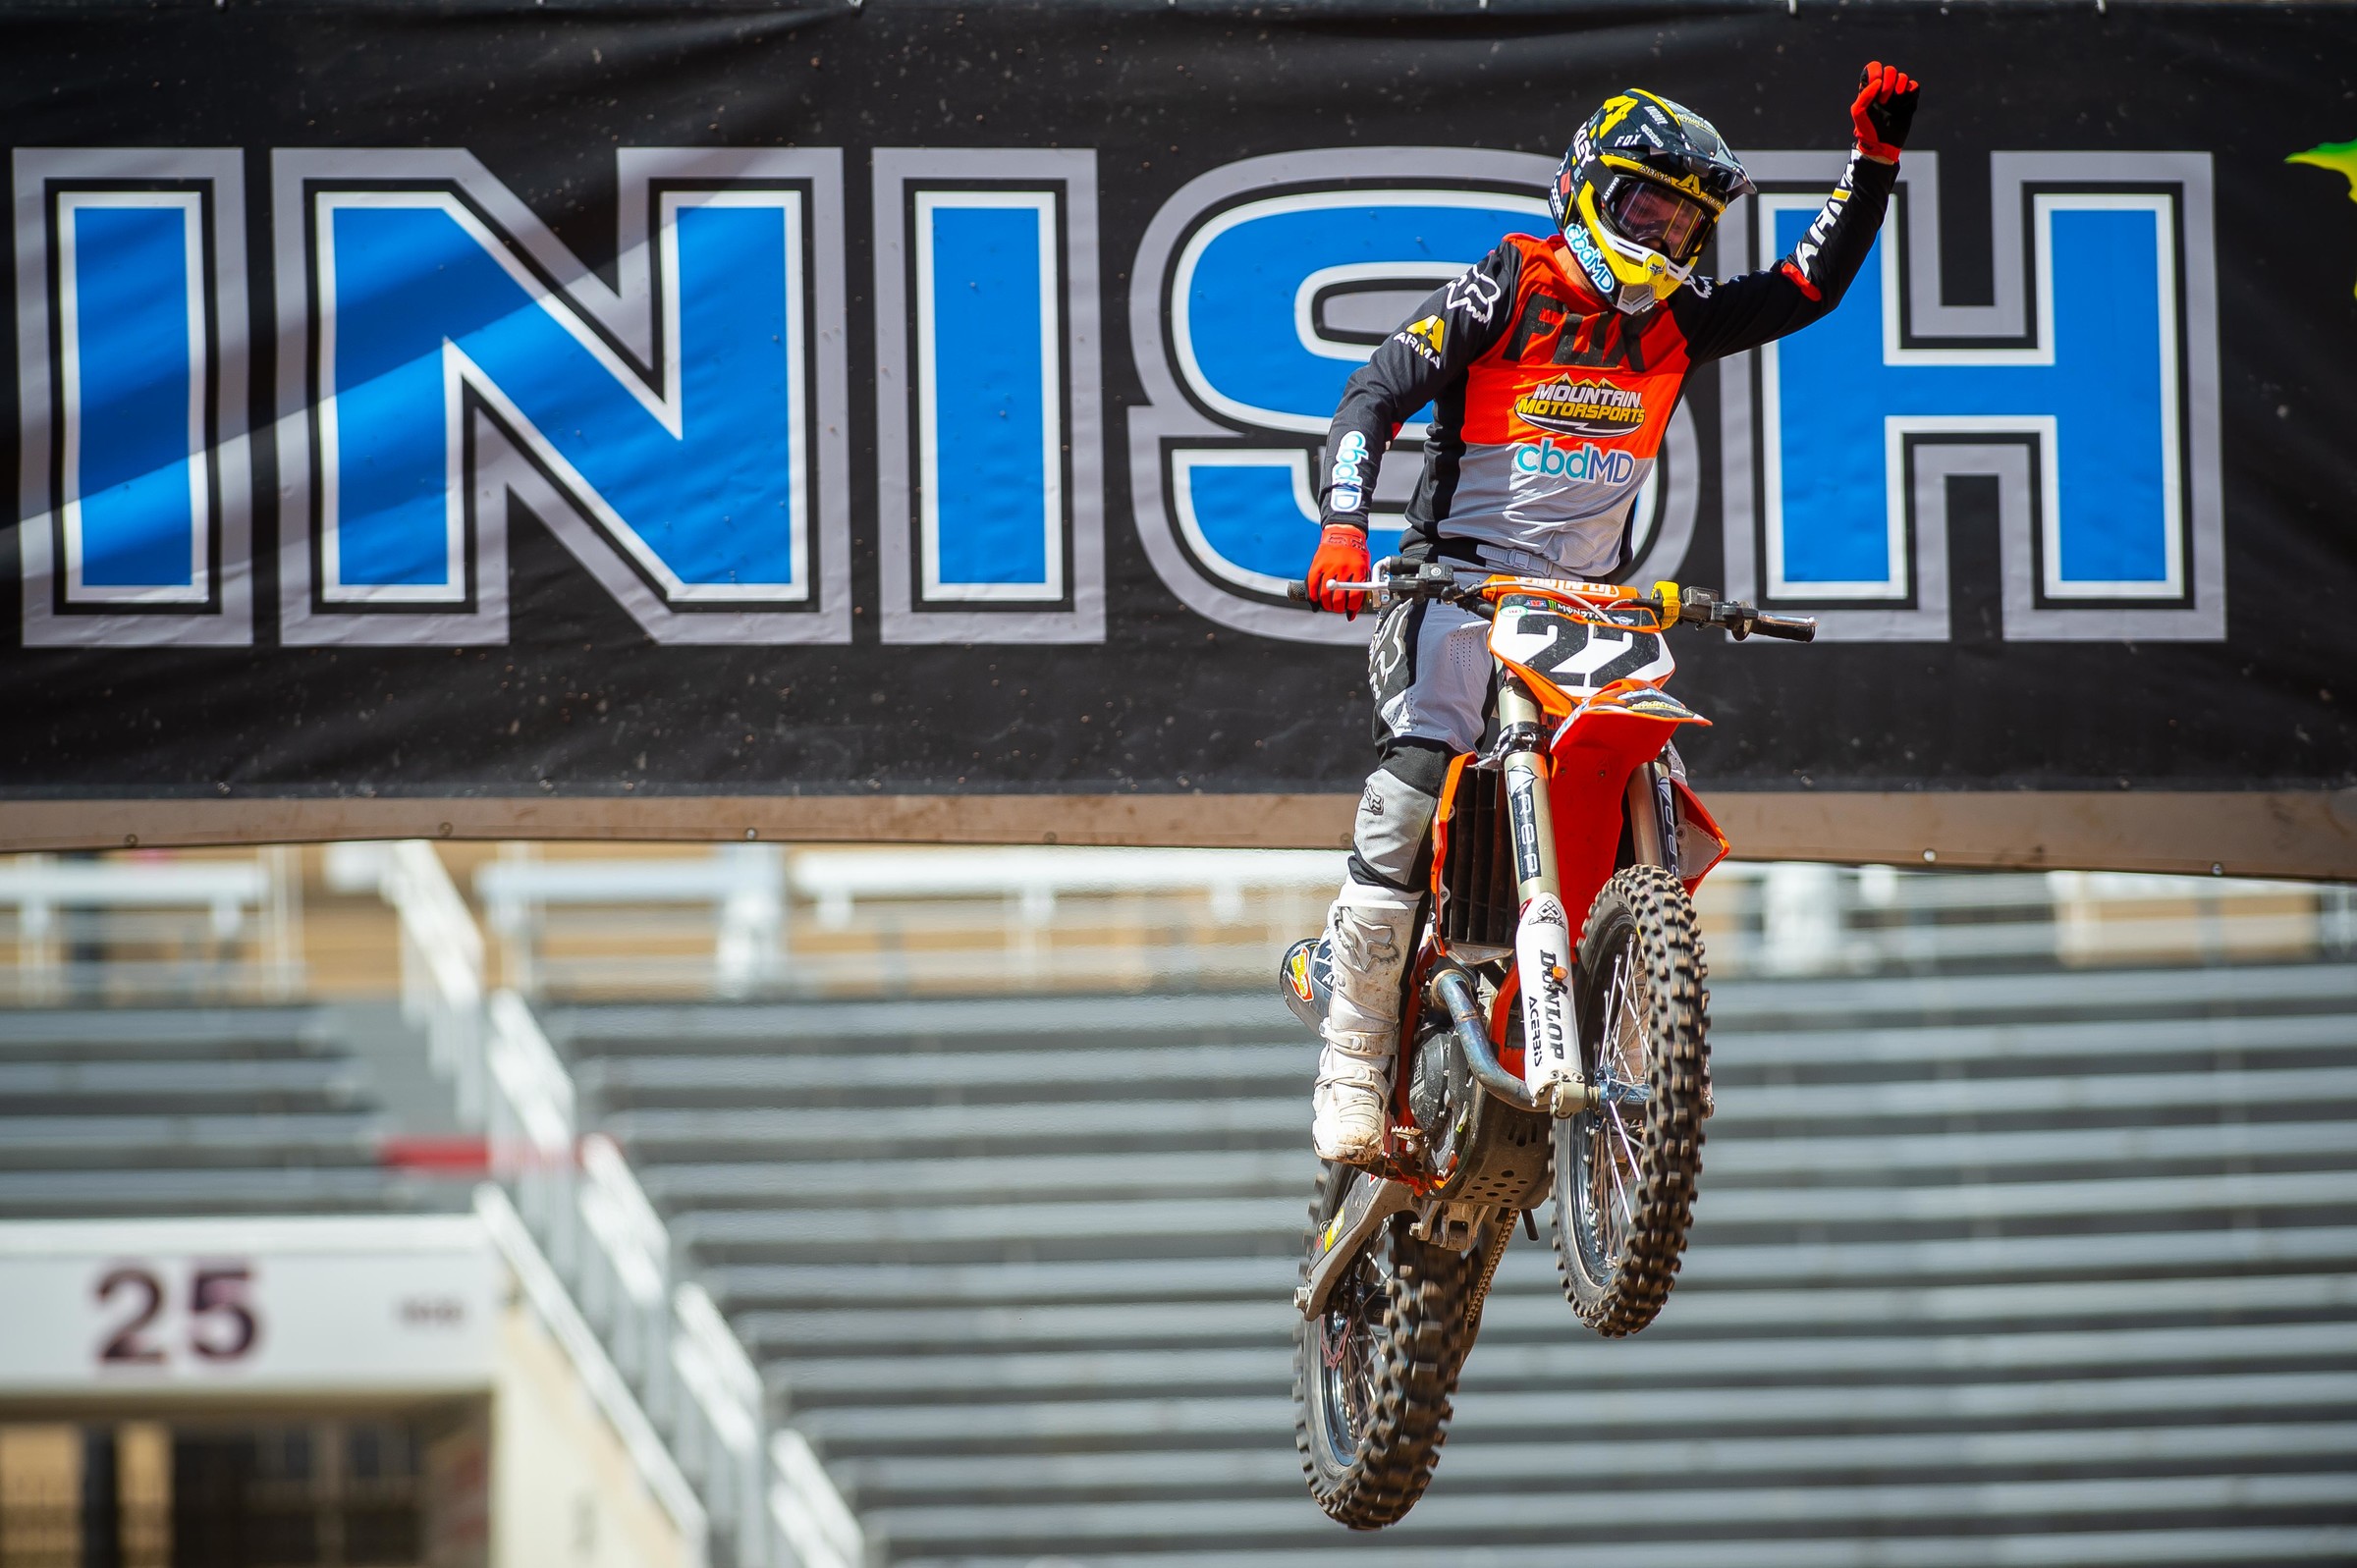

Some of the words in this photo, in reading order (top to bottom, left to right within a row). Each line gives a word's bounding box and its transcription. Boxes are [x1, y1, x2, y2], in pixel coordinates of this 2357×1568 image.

[1615, 134, 1641, 147] FOX
[1563, 224, 1614, 292] cbdMD
[1393, 331, 1441, 370] ARMA
[1516, 398, 1645, 423] MOTORSPORTS
[1532, 383, 1642, 408] MOUNTAIN
[1515, 439, 1634, 484] cbdMD
[1517, 614, 1661, 687] 22
[93, 1264, 259, 1365] 25
